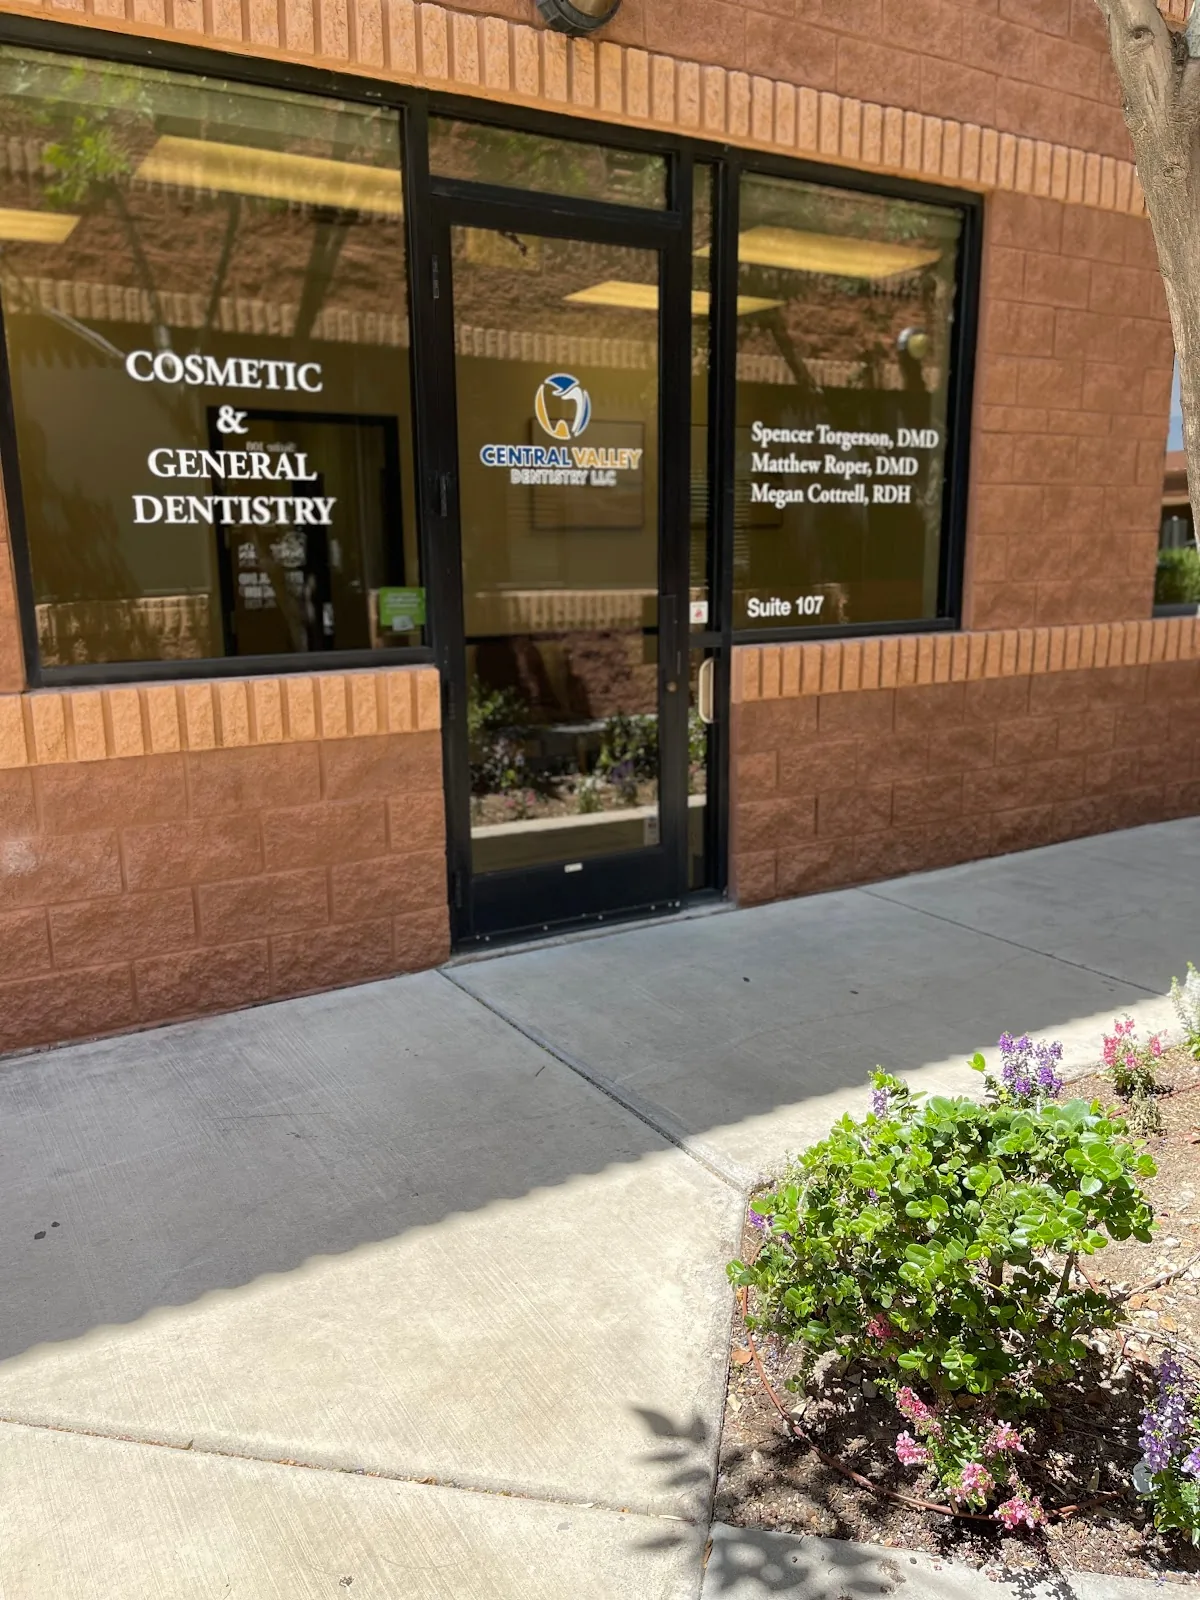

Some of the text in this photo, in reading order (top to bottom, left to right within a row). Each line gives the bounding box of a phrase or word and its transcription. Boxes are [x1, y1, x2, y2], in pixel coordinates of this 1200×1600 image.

[125, 350, 323, 393] COSMETIC
[215, 405, 248, 434] &
[751, 421, 939, 451] Spencer Torgerson, DMD
[147, 448, 318, 482] GENERAL
[480, 444, 642, 470] CENTRAL VALLEY
[751, 452, 919, 479] Matthew Roper, DMD
[510, 468, 616, 486] DENTISTRY LLC
[132, 494, 336, 525] DENTISTRY
[750, 483, 911, 509] Megan Cottrell, RDH
[747, 596, 824, 618] Suite 107
